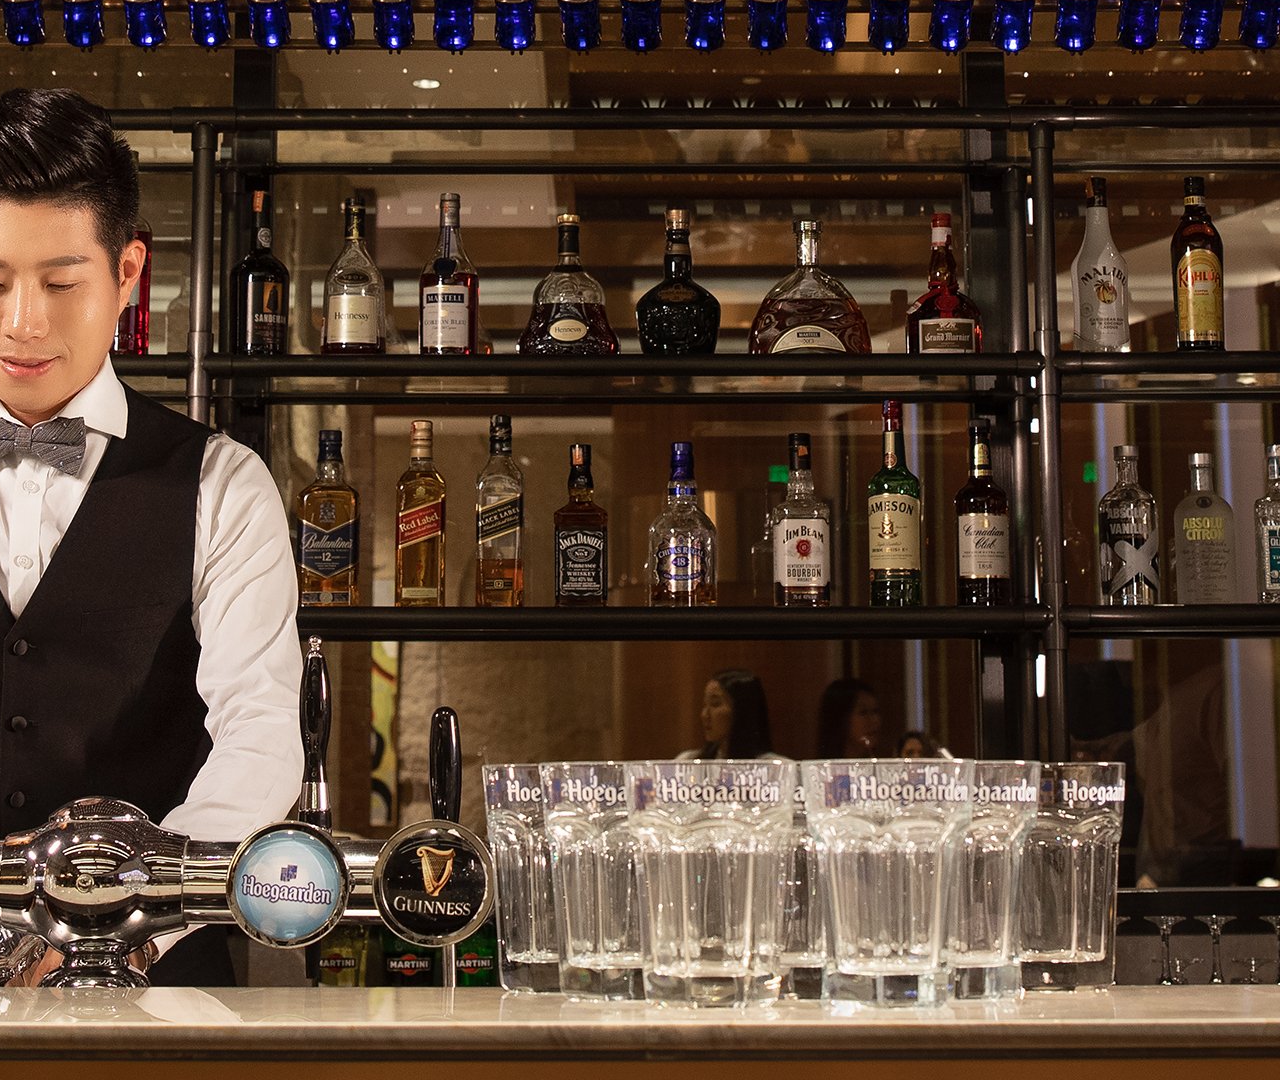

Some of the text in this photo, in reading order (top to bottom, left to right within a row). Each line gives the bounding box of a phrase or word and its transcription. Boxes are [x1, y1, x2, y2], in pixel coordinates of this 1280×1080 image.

[1080, 265, 1128, 287] MALIBU
[661, 777, 780, 807] Hoegaarden
[241, 874, 333, 905] Hoegaarden
[393, 895, 471, 916] GUINNESS
[390, 959, 429, 969] MARTINI
